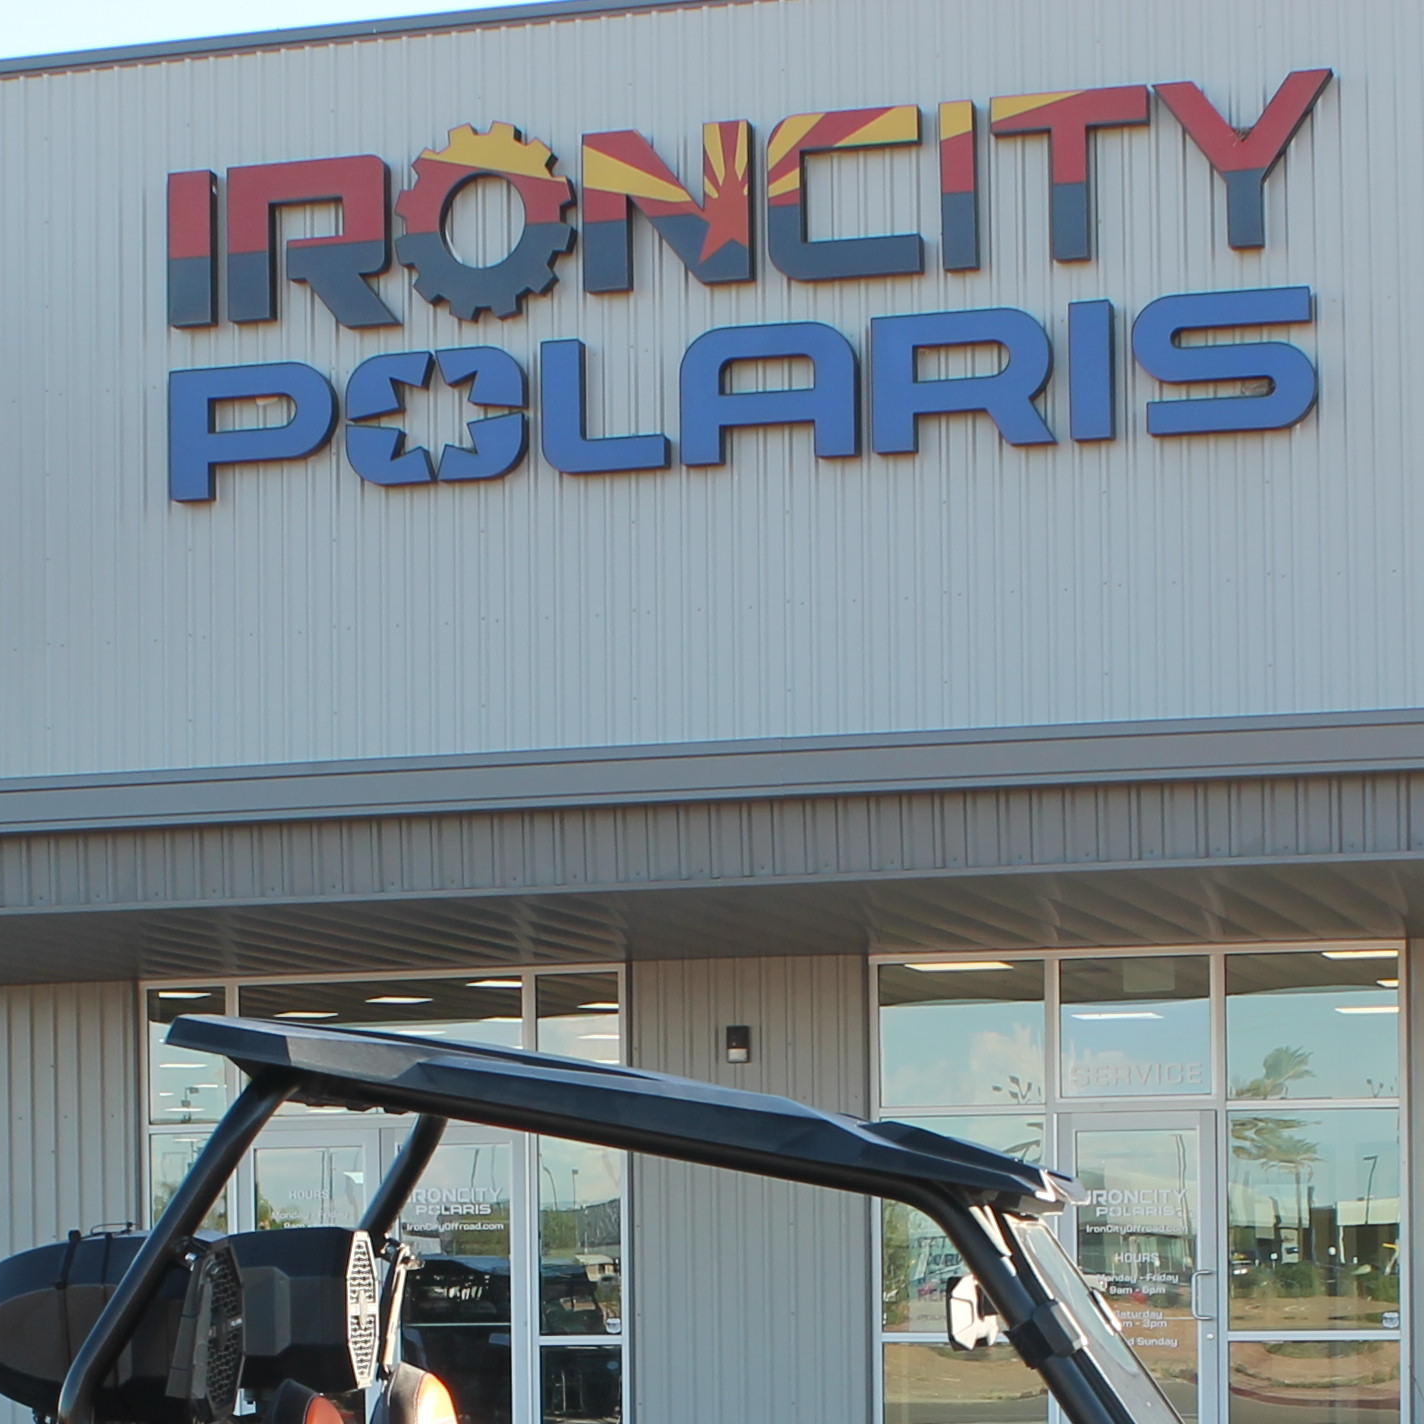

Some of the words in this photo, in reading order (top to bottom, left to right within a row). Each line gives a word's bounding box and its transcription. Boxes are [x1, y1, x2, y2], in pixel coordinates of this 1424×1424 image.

[167, 67, 1334, 328] IRONCITY
[168, 285, 1319, 502] POLARIS
[1070, 1062, 1204, 1088] SERVICE
[288, 1190, 330, 1200] HOURS
[415, 1204, 492, 1215] POLARIS
[1096, 1206, 1176, 1217] POLARIS
[406, 1222, 504, 1232] IronCityOffroad.com
[1086, 1224, 1188, 1235] IronCityOffroad.com
[1115, 1252, 1160, 1263] HOURS
[1096, 1273, 1137, 1283] Monday
[1146, 1273, 1179, 1283] Friday
[1109, 1286, 1133, 1294] 9am
[1115, 1309, 1164, 1320] Saturday
[1143, 1319, 1168, 1329] 3pm
[1136, 1337, 1178, 1348] Sunday
